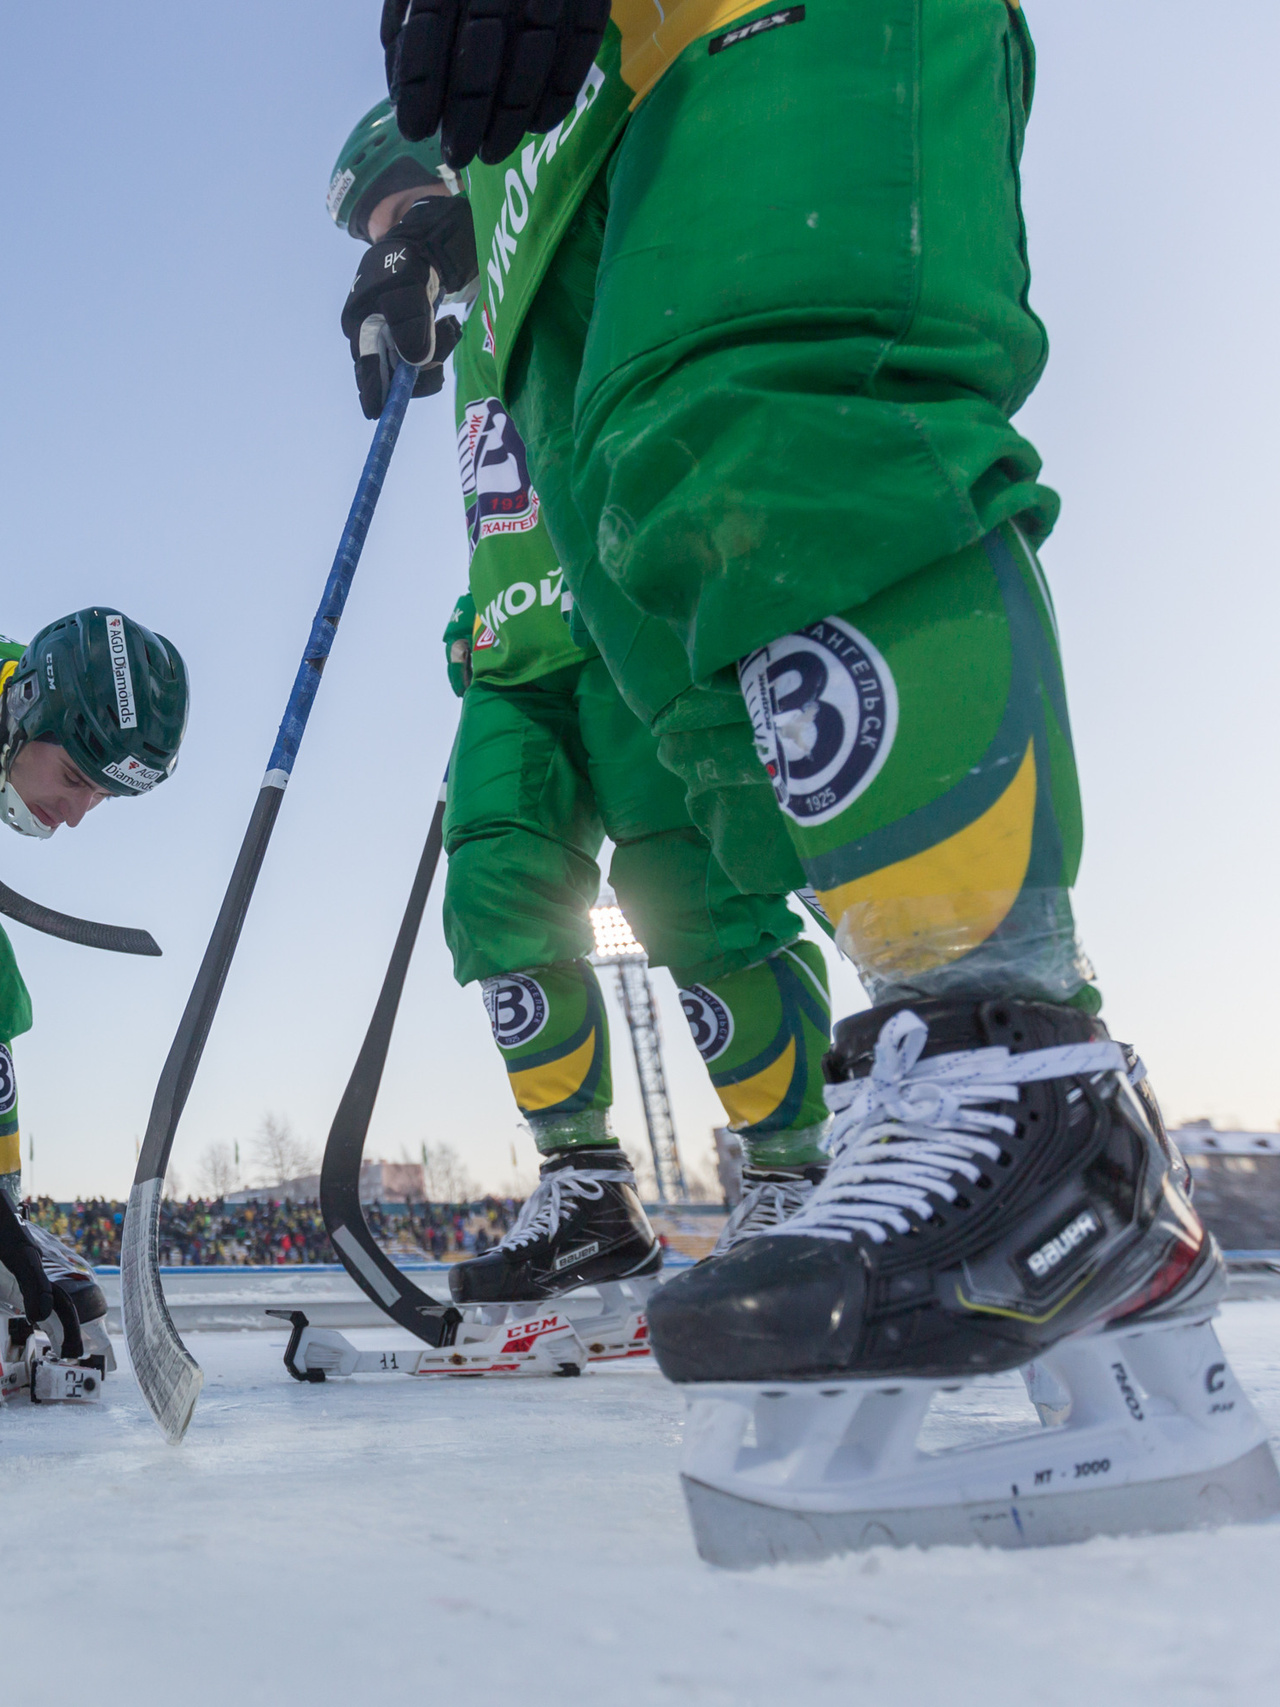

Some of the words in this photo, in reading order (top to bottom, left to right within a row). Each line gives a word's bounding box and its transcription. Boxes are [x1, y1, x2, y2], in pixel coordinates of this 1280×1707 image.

[109, 629, 125, 655] AGD
[113, 656, 135, 724] Diamonds
[810, 624, 882, 749] АНГЕЛЬСК
[135, 767, 159, 780] AGD
[805, 787, 837, 812] 1925
[507, 1315, 559, 1339] CCM
[1074, 1458, 1111, 1478] 3000
